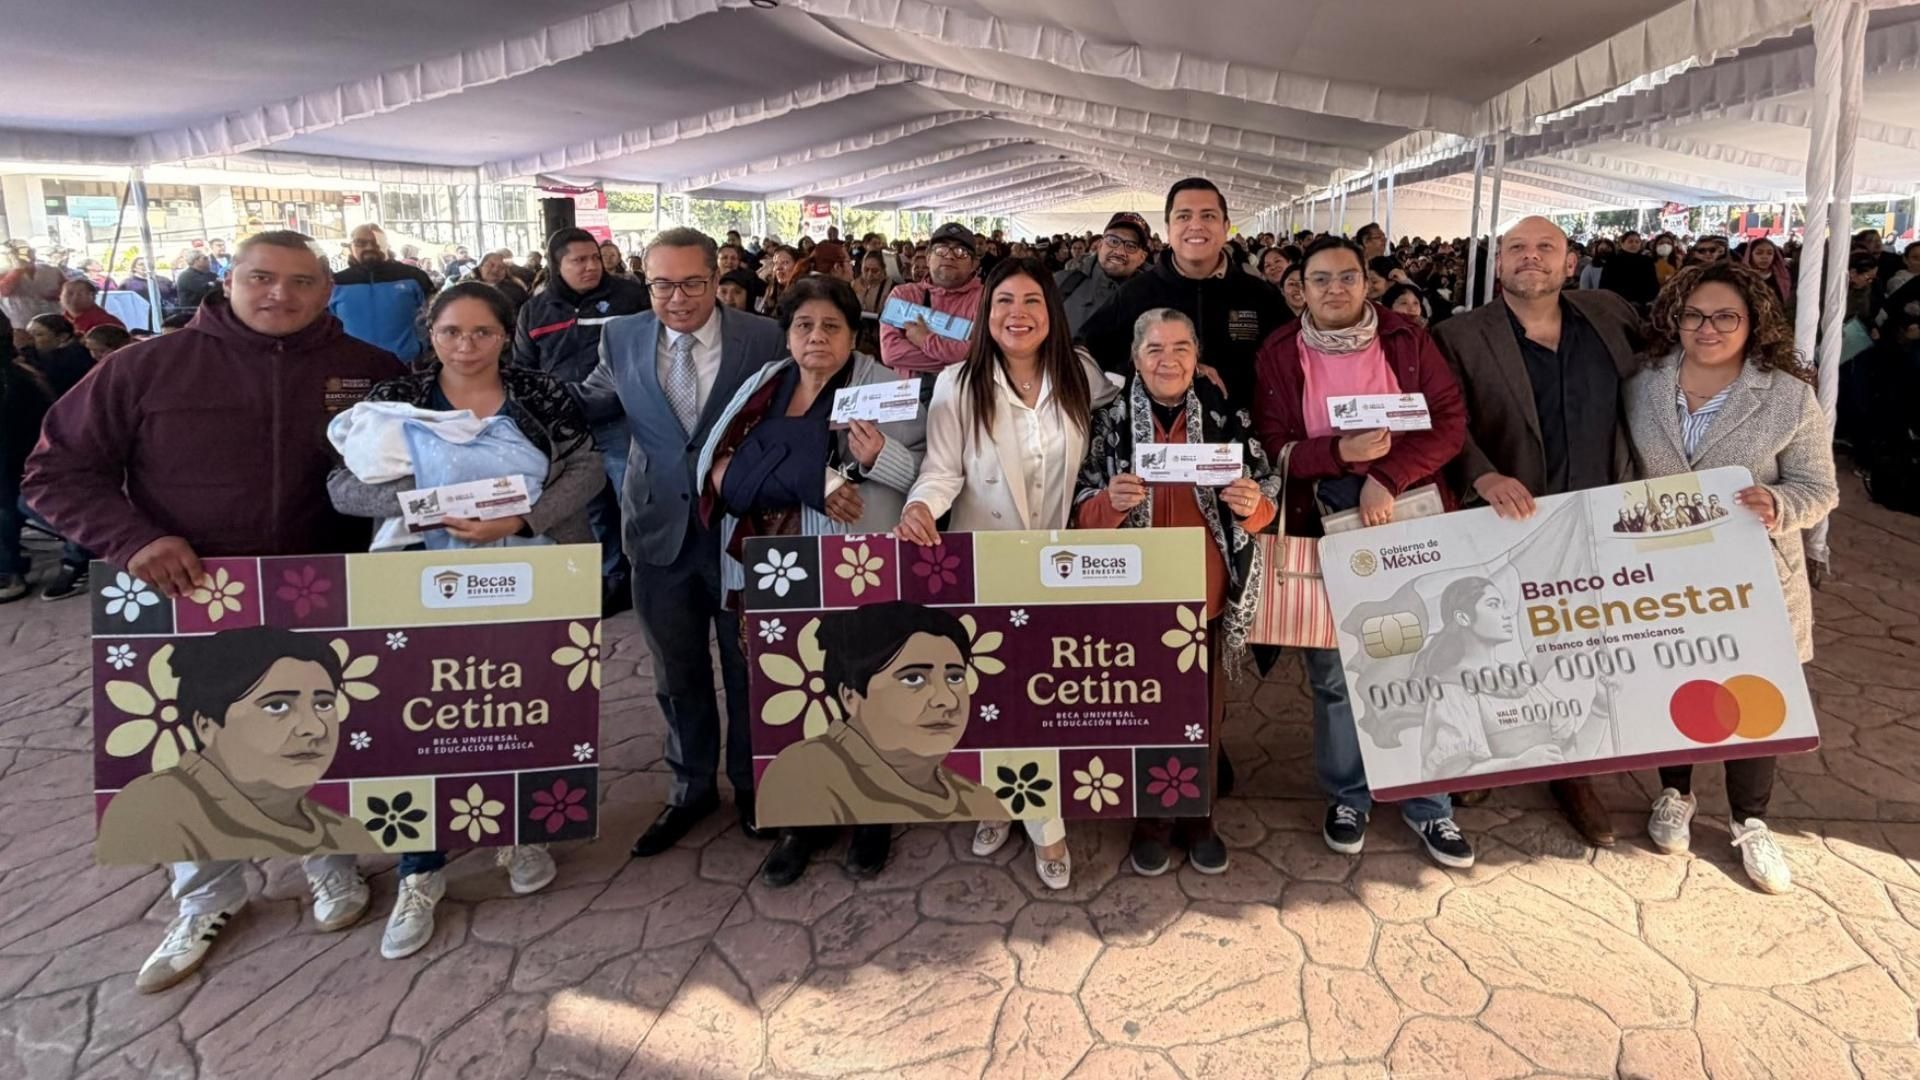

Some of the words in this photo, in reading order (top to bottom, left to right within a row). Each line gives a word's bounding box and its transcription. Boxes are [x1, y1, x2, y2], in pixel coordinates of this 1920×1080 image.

[1379, 541, 1425, 556] Gobierno
[1427, 539, 1439, 548] de
[1081, 555, 1127, 568] Becas
[1382, 550, 1441, 570] México
[466, 575, 517, 588] Becas
[1521, 575, 1605, 601] Banco
[1613, 563, 1655, 587] del
[1526, 582, 1754, 638] Bienestar
[1536, 644, 1548, 654] El
[1549, 638, 1584, 653] banco
[1586, 636, 1601, 647] de
[1602, 634, 1620, 645] los
[1622, 625, 1686, 643] mexicanos
[1051, 635, 1136, 669] Rita
[431, 656, 523, 692] Rita
[1369, 675, 1444, 710] 0000
[1461, 660, 1538, 695] 0000
[1554, 646, 1636, 682] 0000
[1653, 633, 1740, 670] 0000
[1026, 671, 1162, 706] Cetina
[402, 693, 549, 732] Cetina
[1083, 711, 1136, 719] UNIVERSAL
[1496, 708, 1518, 718] VALID
[1521, 698, 1582, 723] 00/00
[1498, 717, 1519, 726] THRU
[1042, 720, 1054, 728] DE
[1057, 717, 1112, 727] EDUCACIÓN
[1116, 716, 1150, 727] BÁSICA
[417, 746, 430, 755] DE
[434, 743, 493, 754] EDUCACIÓN
[497, 741, 535, 751] BÁSICA
[433, 737, 459, 746] BECA
[462, 734, 519, 744] UNIVERSAL
